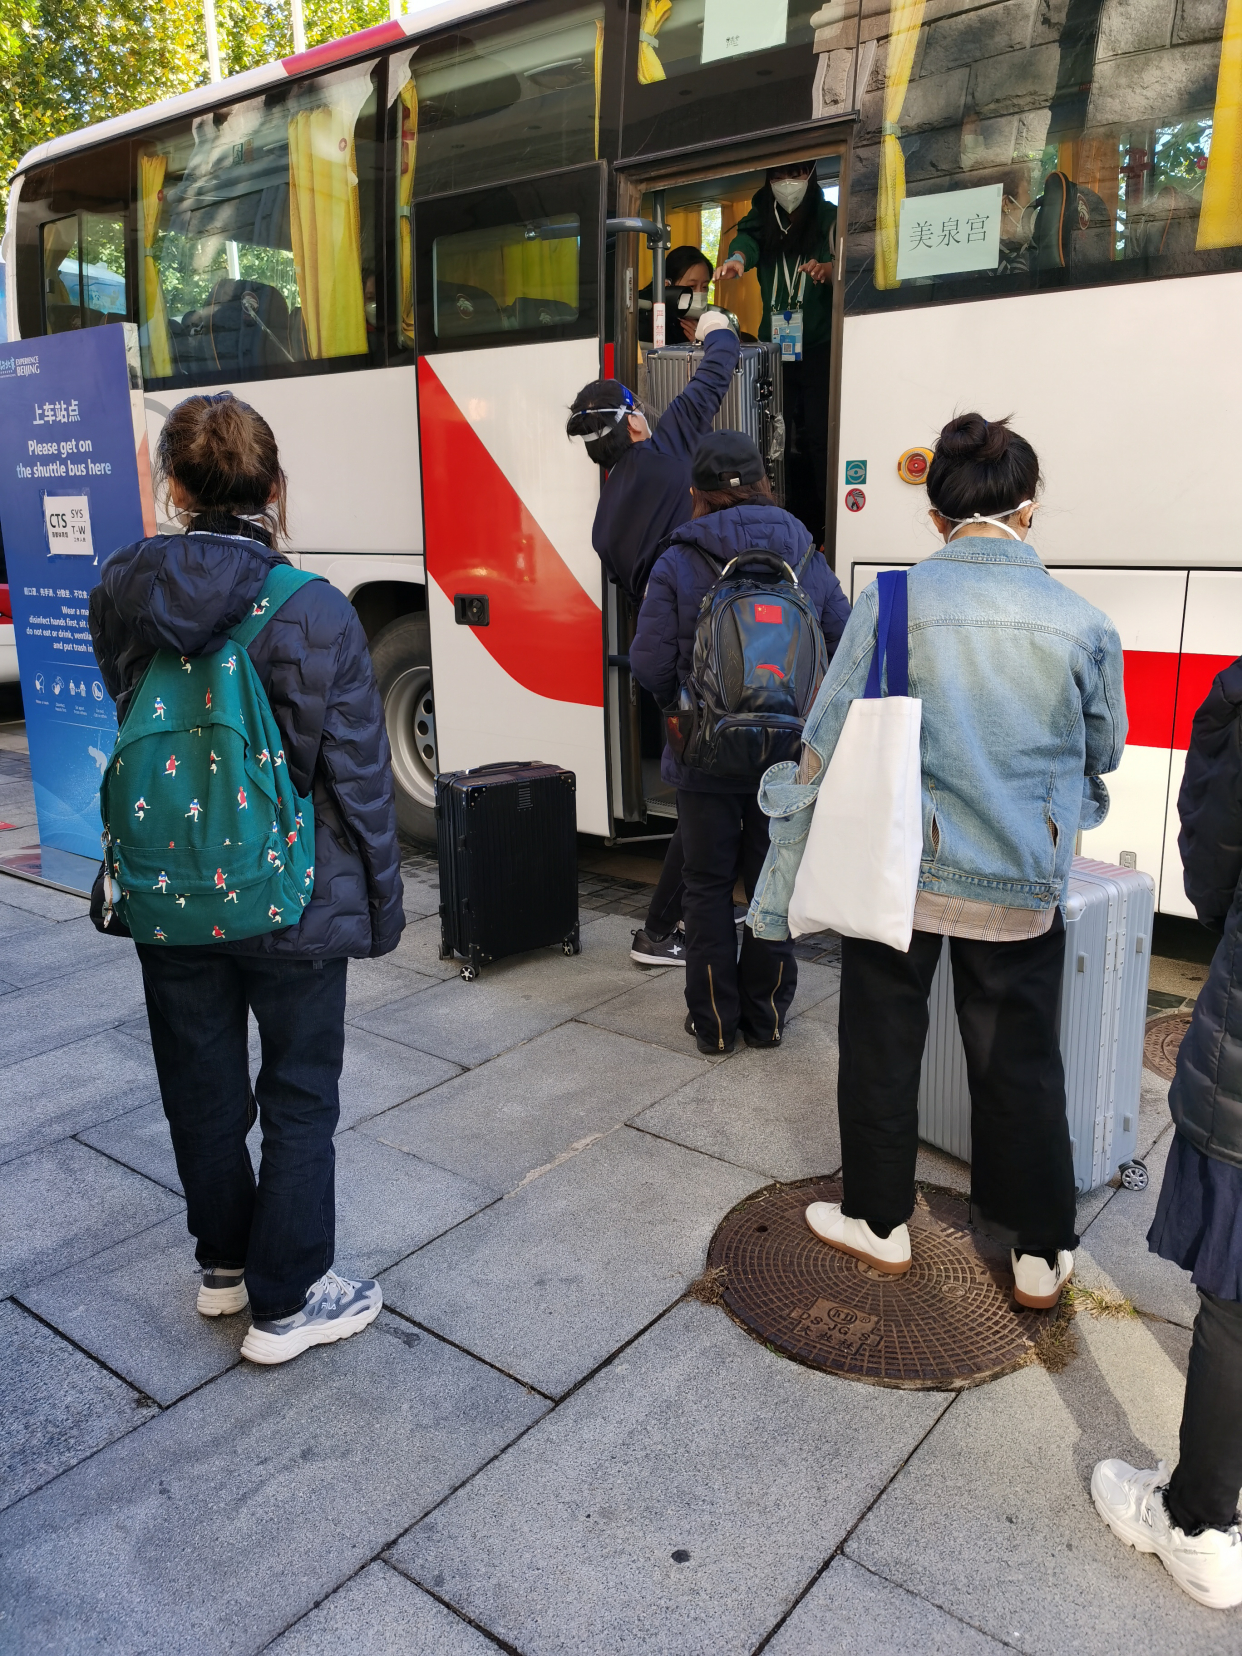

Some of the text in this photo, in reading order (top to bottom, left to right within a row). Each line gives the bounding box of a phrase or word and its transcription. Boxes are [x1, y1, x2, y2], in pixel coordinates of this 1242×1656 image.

[908, 213, 989, 252] 美泉宫
[15, 355, 39, 366] EXPERIENCE
[16, 364, 40, 377] BEIJING
[33, 399, 81, 425] 上车站点
[28, 438, 92, 458] Please get on
[16, 459, 111, 478] the shuttle bus here
[50, 513, 67, 528] CTS
[70, 509, 84, 519] SYS
[71, 525, 86, 535] T-W
[61, 605, 75, 615] Wear
[29, 615, 50, 625] disinfect
[50, 616, 66, 626] hands
[66, 617, 78, 628] first,
[26, 627, 33, 635] do
[58, 629, 73, 640] drink,
[53, 641, 63, 650] and
[64, 643, 73, 652] put
[73, 643, 87, 652] trash
[321, 1302, 336, 1310] FILA
[799, 1311, 871, 1342] DS-JG-S
